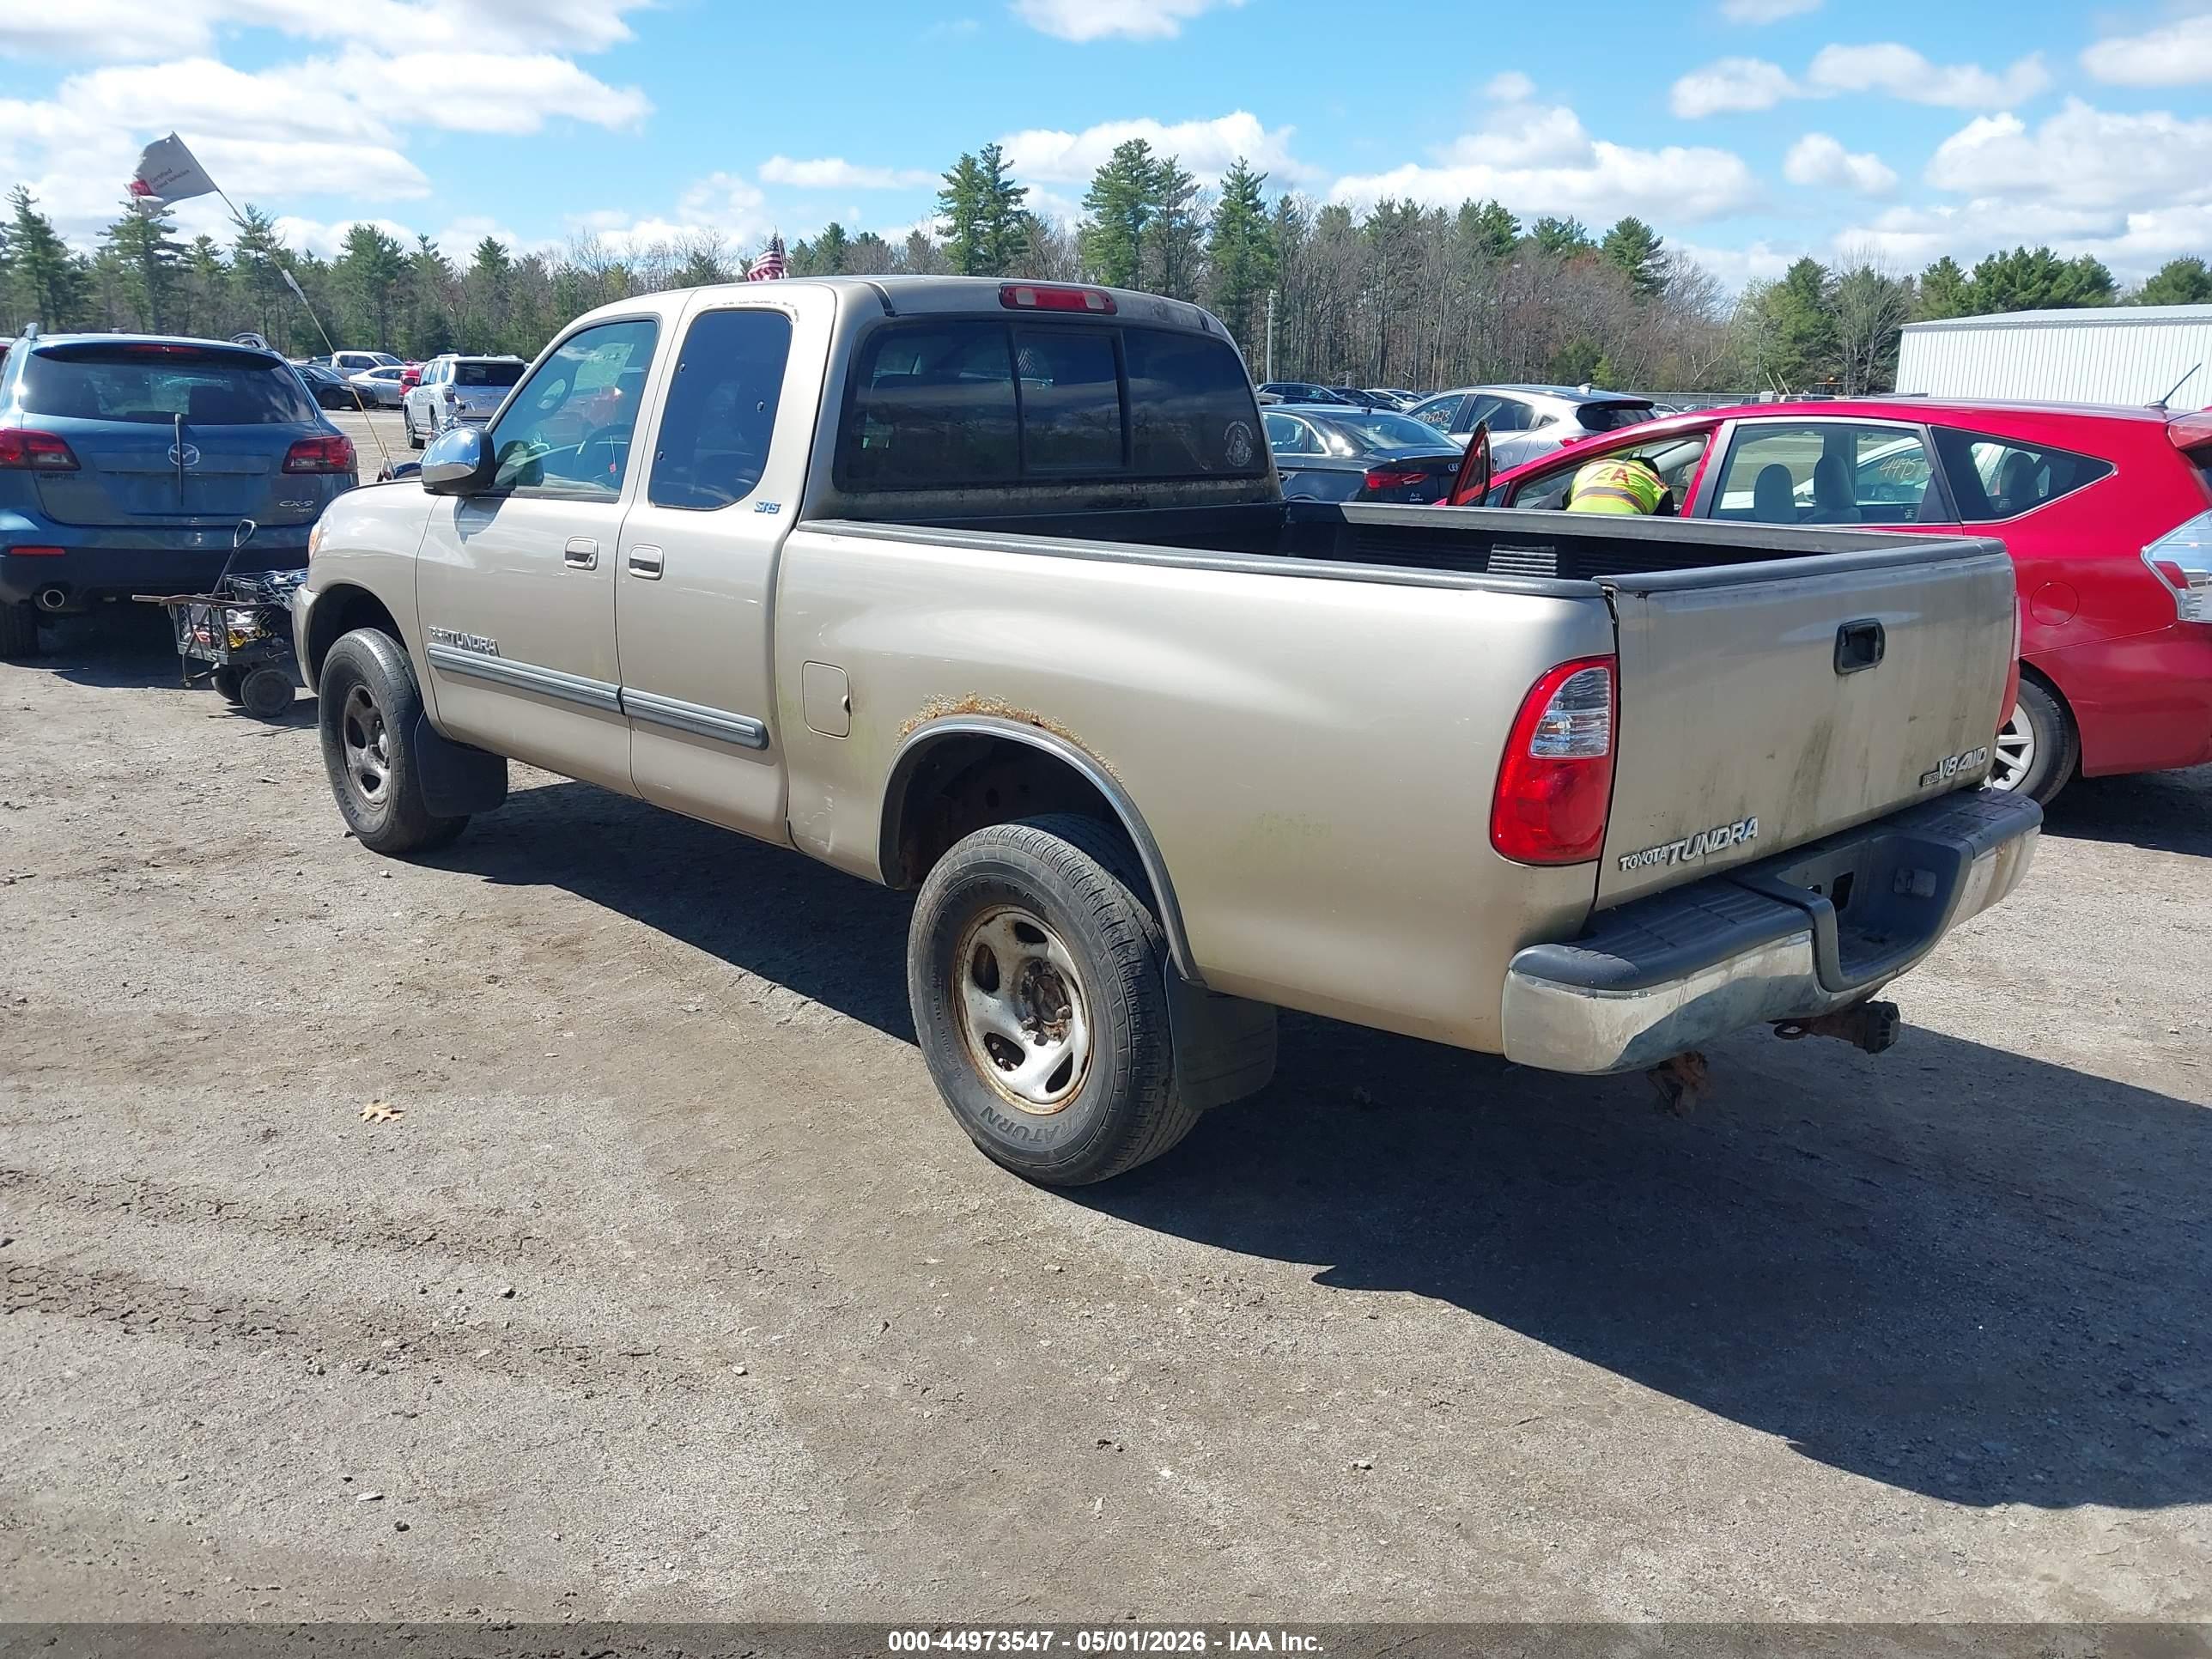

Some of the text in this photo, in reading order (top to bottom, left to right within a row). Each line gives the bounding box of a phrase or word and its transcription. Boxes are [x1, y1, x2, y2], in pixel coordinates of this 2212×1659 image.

[754, 501, 781, 514] SR5
[1938, 756, 1959, 780] V8
[1618, 816, 1759, 872] TOYOTA TUNDRA
